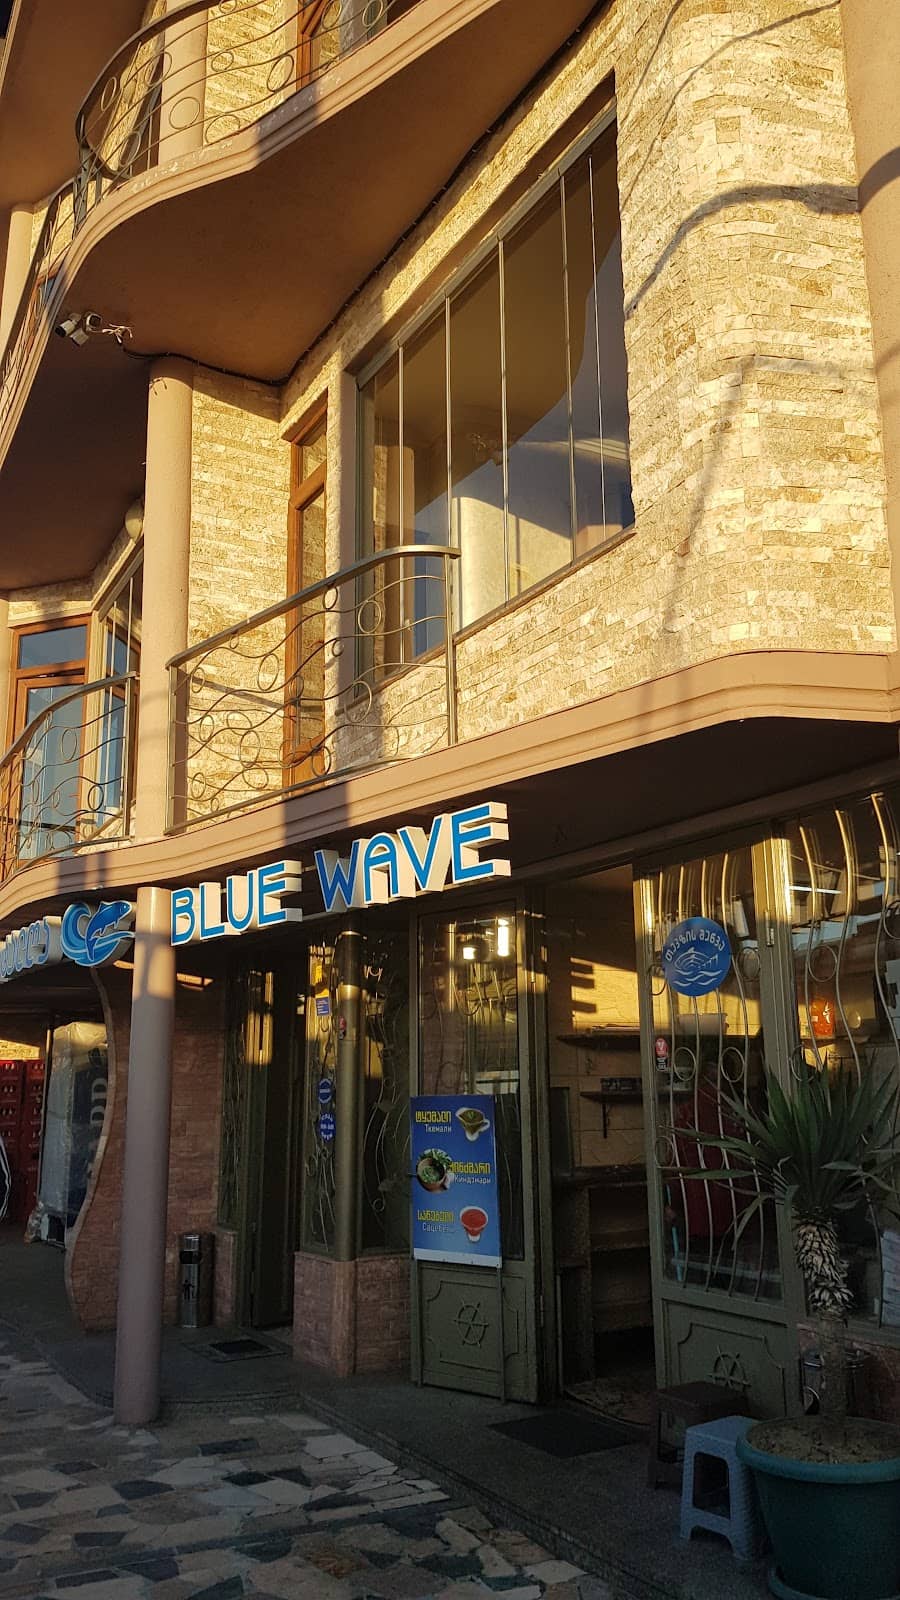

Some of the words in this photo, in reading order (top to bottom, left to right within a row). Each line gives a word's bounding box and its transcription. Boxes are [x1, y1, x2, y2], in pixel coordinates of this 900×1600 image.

[170, 859, 303, 947] BLUE
[314, 801, 512, 912] WAVE
[665, 930, 697, 961] თევზის
[425, 1124, 452, 1133] Ткемали
